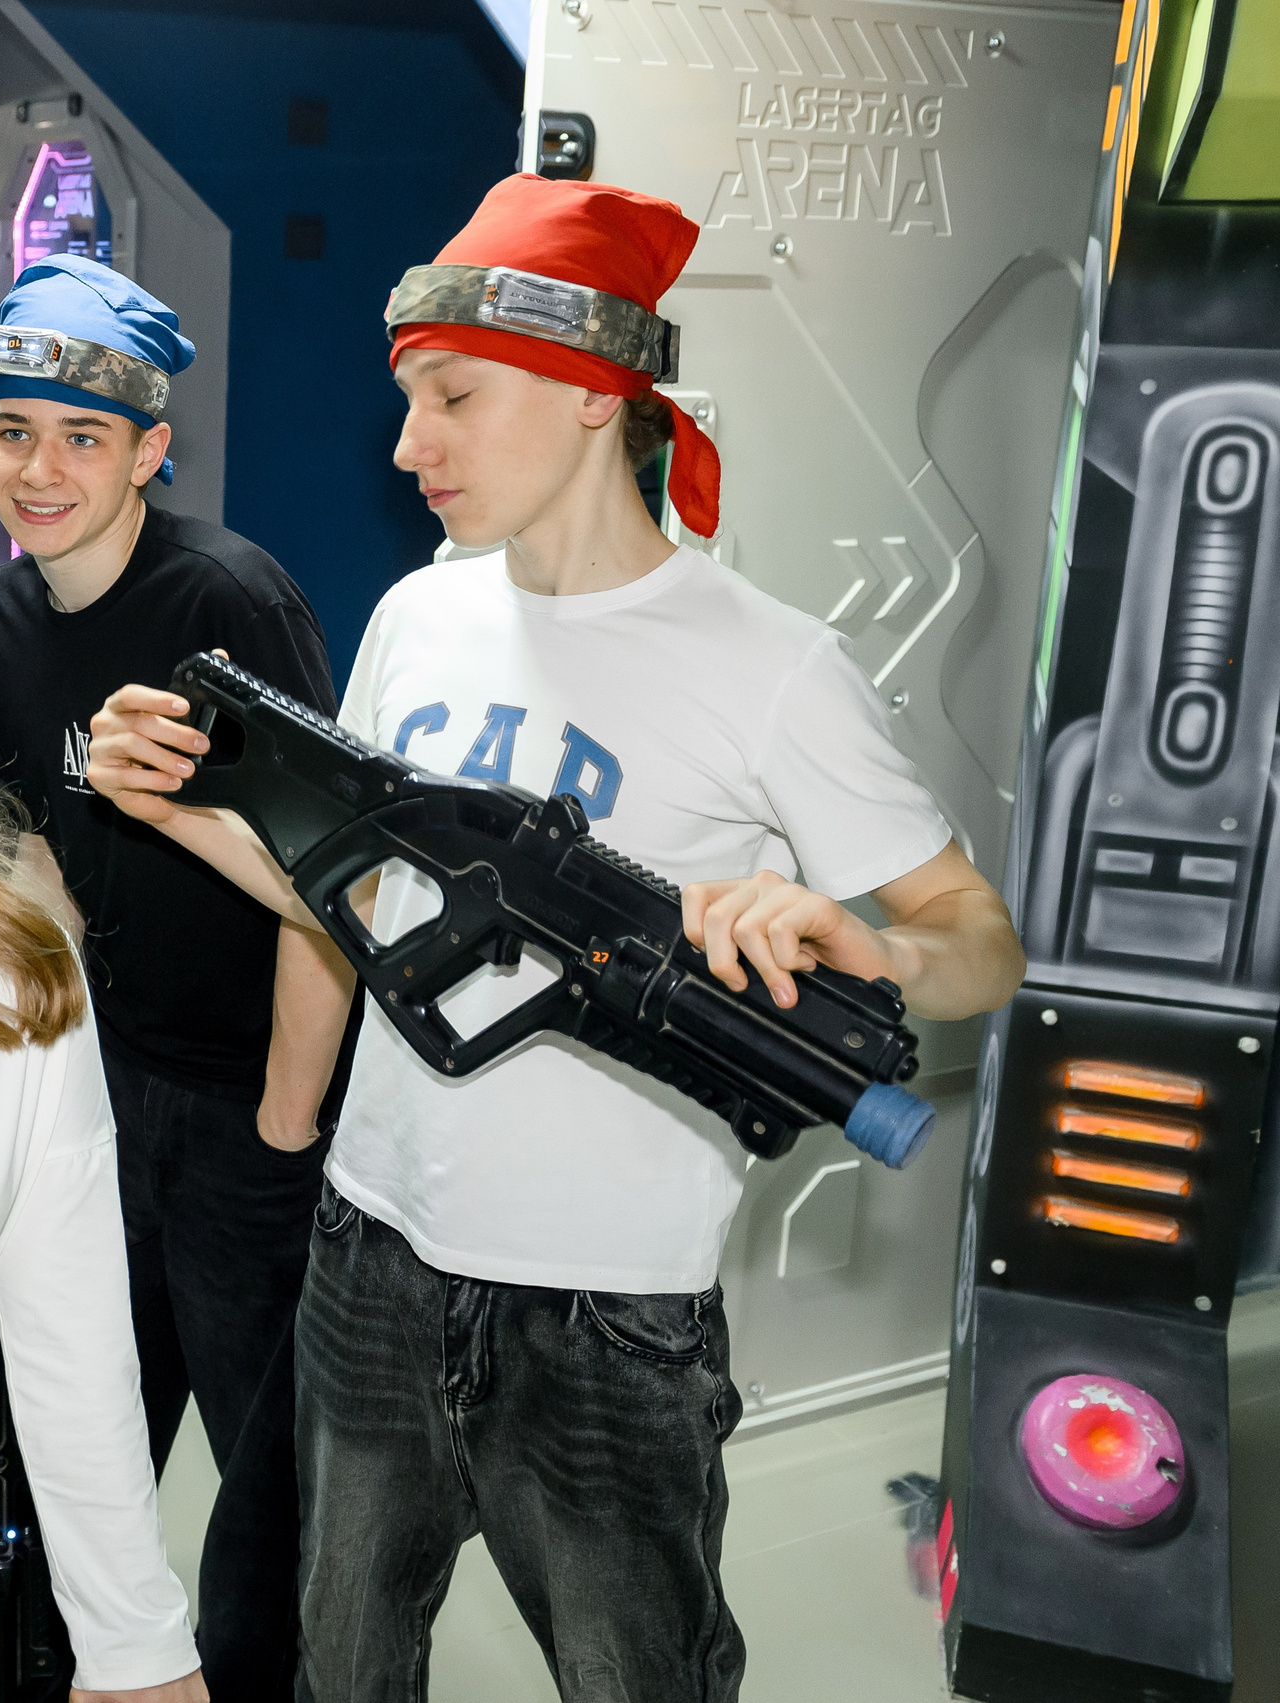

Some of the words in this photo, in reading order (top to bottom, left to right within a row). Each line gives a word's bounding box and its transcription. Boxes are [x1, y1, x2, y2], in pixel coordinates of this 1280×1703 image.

[737, 82, 943, 138] LASERTAG
[704, 138, 952, 236] ARENA
[592, 951, 610, 963] 27
